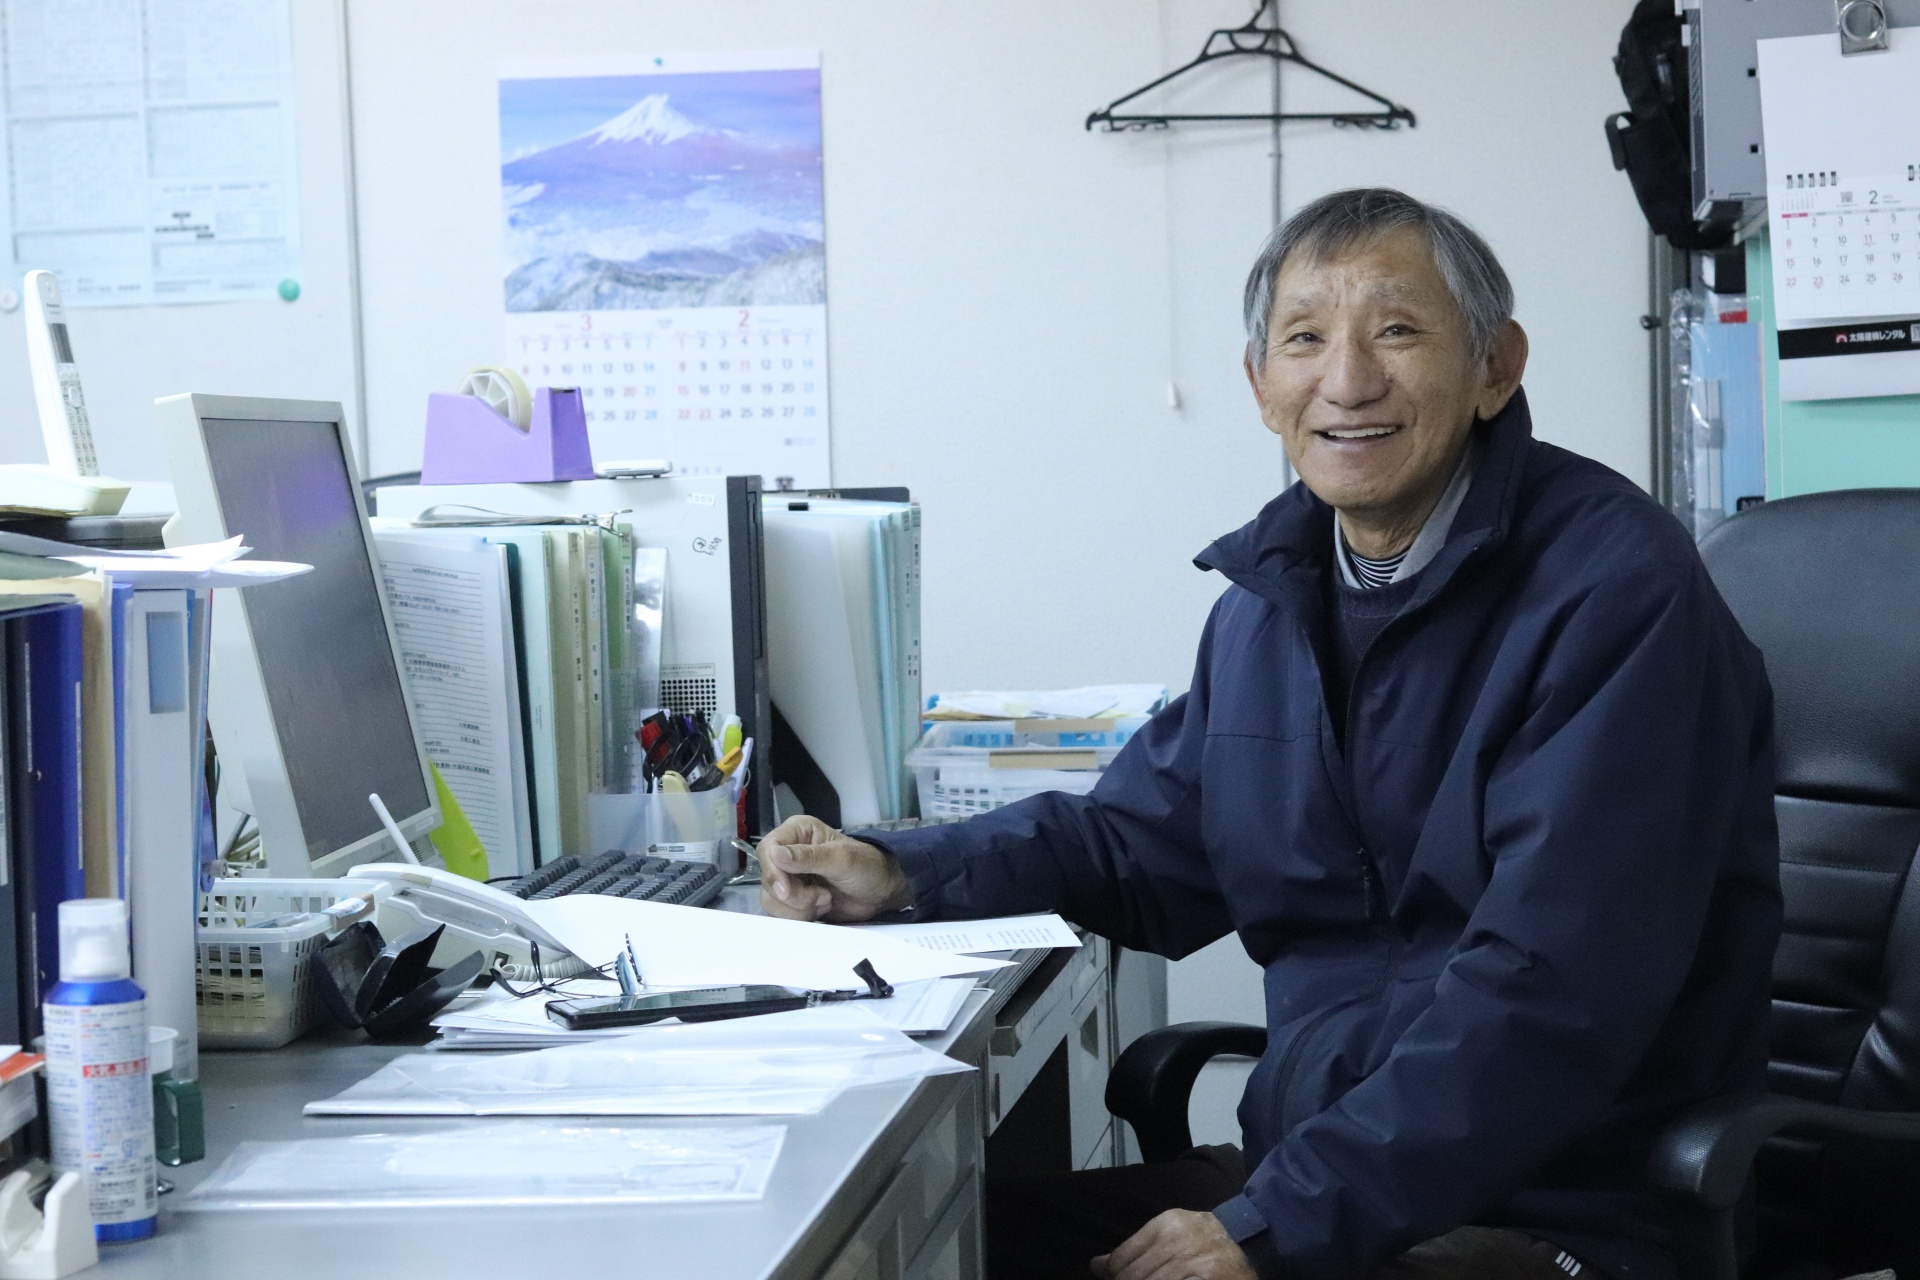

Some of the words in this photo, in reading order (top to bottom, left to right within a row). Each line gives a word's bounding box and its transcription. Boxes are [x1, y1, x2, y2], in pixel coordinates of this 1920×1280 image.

[1869, 190, 1878, 204] 2
[1786, 239, 1792, 247] 8
[1813, 237, 1818, 245] 9
[1838, 236, 1847, 244] 10
[1864, 235, 1872, 243] 11
[1891, 233, 1900, 241] 12
[1786, 258, 1795, 266] 15
[1813, 257, 1821, 265] 16
[1839, 255, 1848, 263] 17
[1866, 254, 1874, 262] 18
[1892, 252, 1901, 260] 19
[1786, 278, 1796, 286] 22
[1813, 276, 1823, 285] 23
[1840, 275, 1850, 283] 24
[1866, 274, 1876, 282] 25
[580, 314, 592, 331] 3
[738, 309, 749, 327] 2
[522, 364, 529, 375] 8
[543, 364, 550, 375] 9
[561, 364, 573, 374] 10
[583, 363, 592, 374] 11
[603, 363, 613, 374] 12
[624, 363, 634, 373] 13
[644, 362, 655, 372] 14
[679, 361, 686, 372] 8
[700, 360, 707, 371] 9
[719, 360, 730, 370] 10
[740, 360, 750, 371] 11
[761, 359, 771, 370] 12
[782, 358, 793, 369] 13
[802, 358, 814, 368] 14
[583, 386, 594, 397] 18
[604, 386, 615, 397] 19
[623, 386, 636, 397] 20
[645, 386, 655, 396] 21
[678, 384, 689, 395] 15
[699, 384, 710, 395] 16
[720, 384, 730, 394] 17
[741, 383, 751, 393] 18
[762, 383, 773, 394] 19
[781, 382, 794, 393] 20
[803, 382, 814, 393] 21
[604, 410, 616, 421] 26
[625, 410, 636, 421] 27
[645, 410, 657, 420] 28
[678, 409, 690, 419] 22
[699, 408, 711, 419] 23
[720, 408, 731, 418] 24
[740, 408, 753, 418] 25
[761, 407, 774, 417] 26
[782, 406, 794, 417] 27
[803, 406, 816, 416] 28
